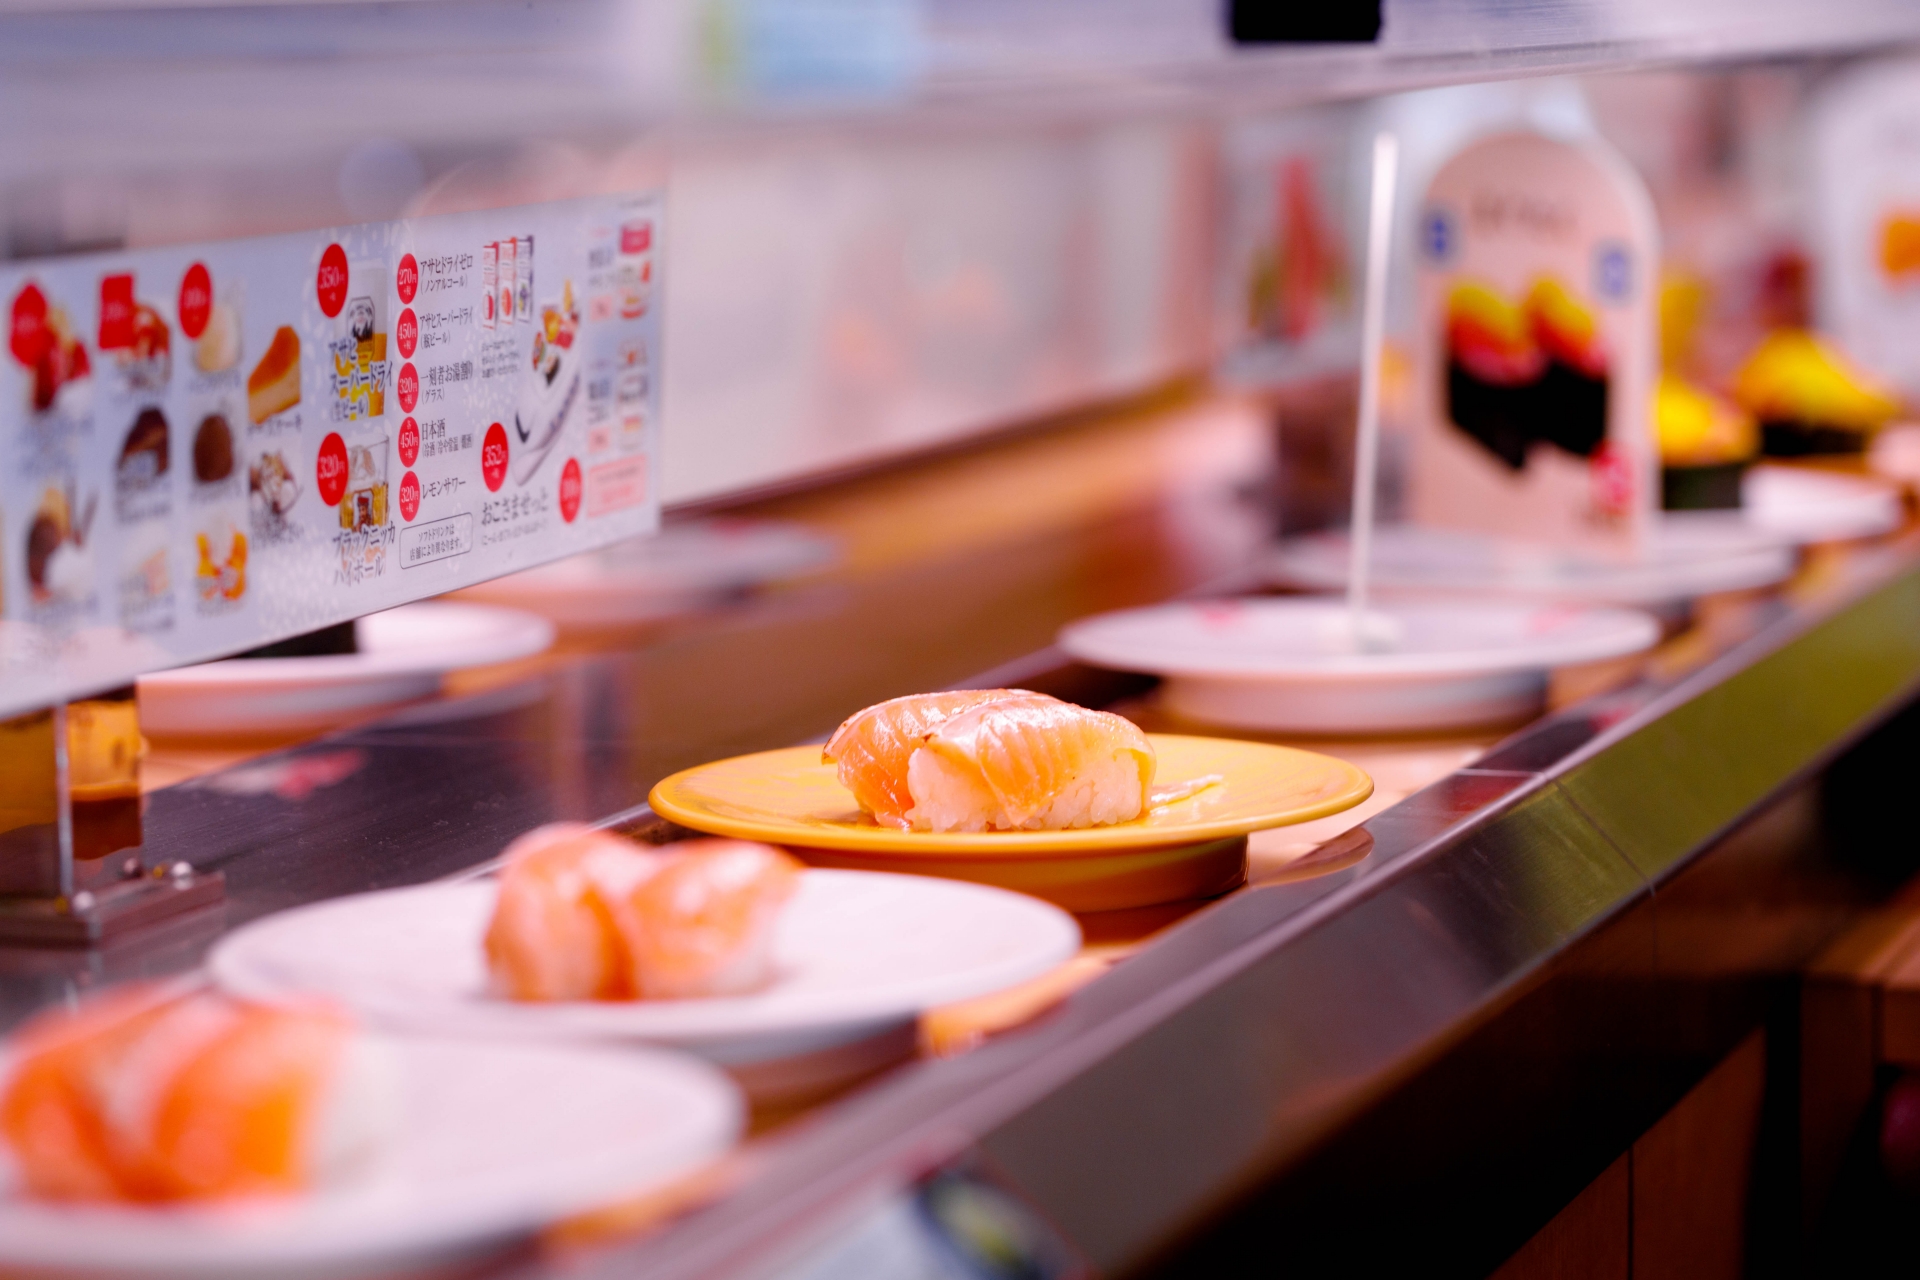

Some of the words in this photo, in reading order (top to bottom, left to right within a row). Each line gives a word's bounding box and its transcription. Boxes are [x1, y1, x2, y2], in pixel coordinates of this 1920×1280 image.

[420, 253, 473, 277] アサヒドライゼロ
[399, 268, 416, 285] 270円
[420, 306, 473, 331] アサヒスーパードライ
[398, 323, 417, 339] 450円
[328, 338, 358, 366] アサヒ
[329, 361, 393, 396] スーパードライ
[399, 377, 418, 394] 320円
[421, 386, 445, 405] (グラス)
[400, 431, 419, 448] 450円
[421, 418, 446, 441] 日本酒
[401, 485, 419, 503] 320円
[422, 477, 466, 499] レモンサワー
[332, 520, 396, 558] ブラックニッカ
[333, 555, 384, 587] ハイボール
